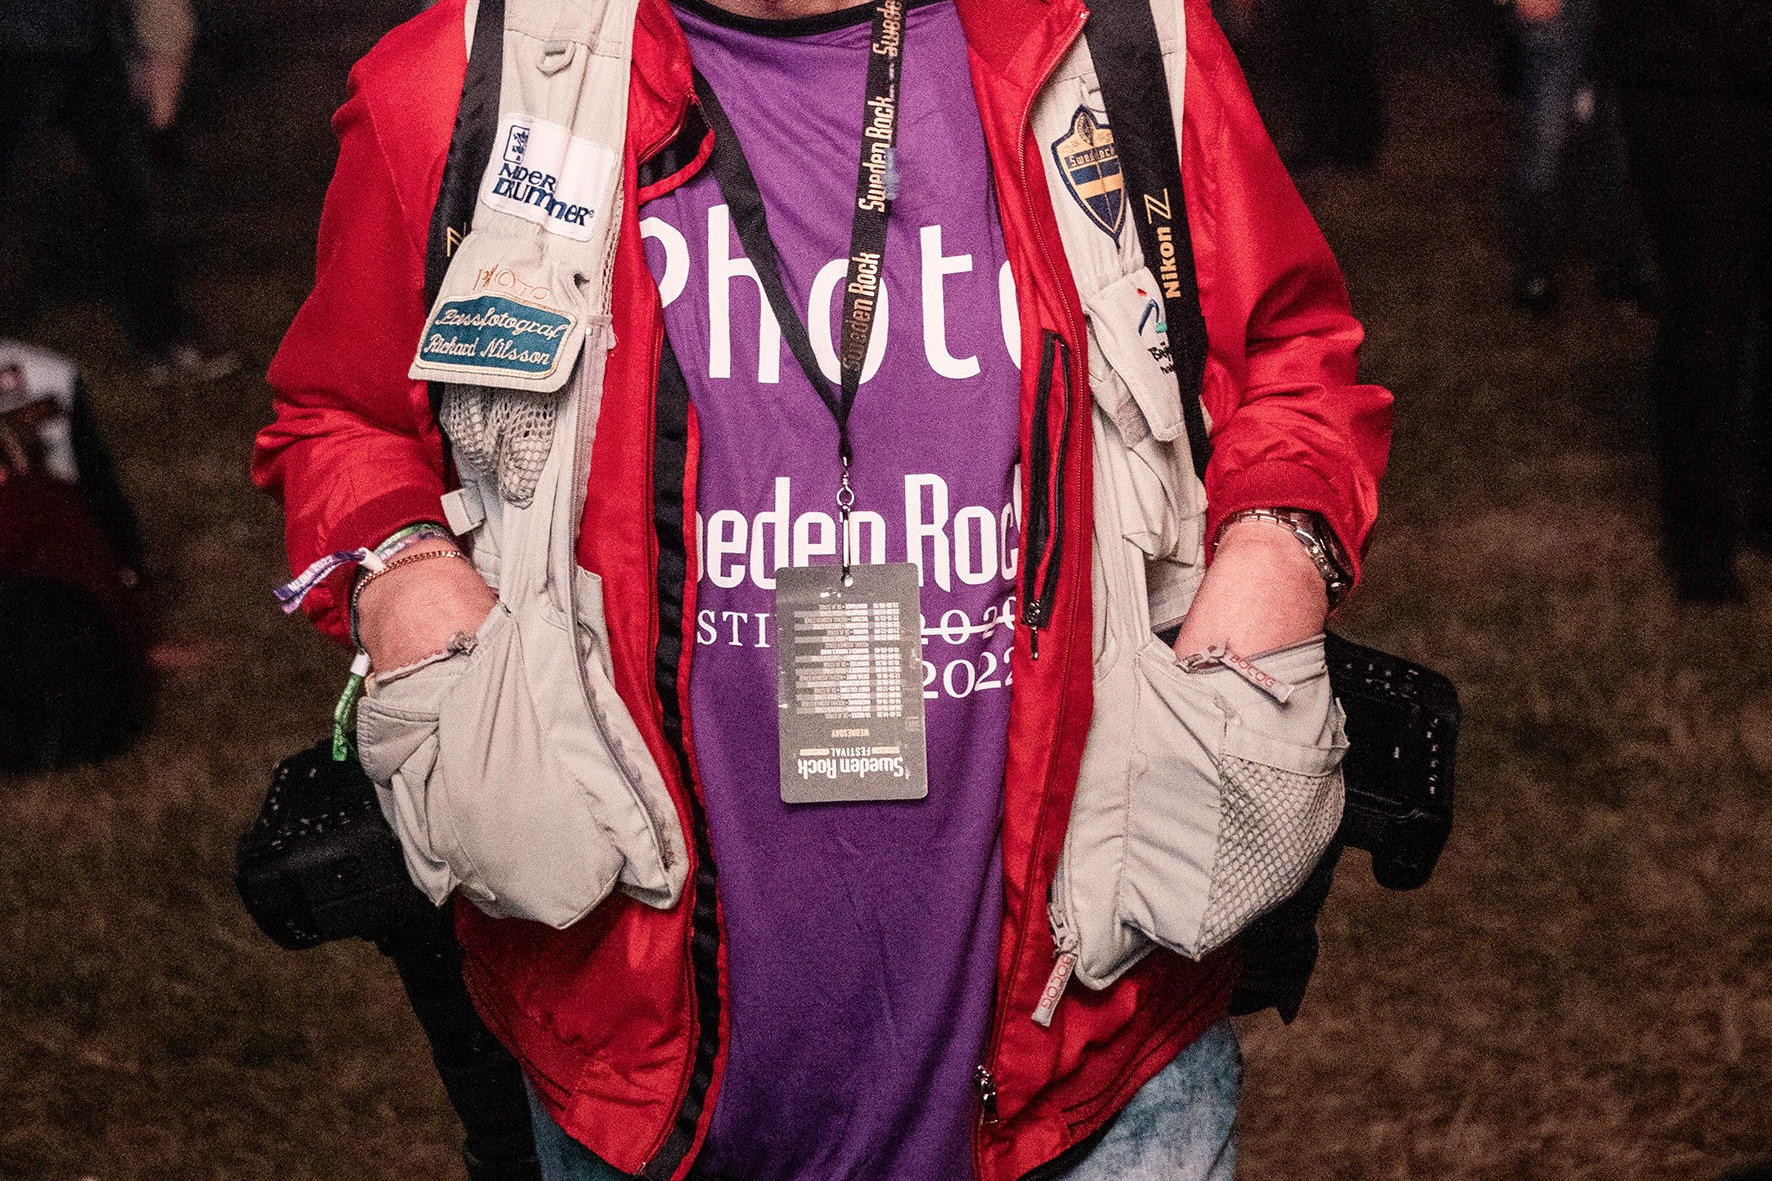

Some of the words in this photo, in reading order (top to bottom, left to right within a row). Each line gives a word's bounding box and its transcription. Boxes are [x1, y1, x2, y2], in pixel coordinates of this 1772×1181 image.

[865, 95, 895, 143] Rock
[859, 140, 890, 213] Sweden
[848, 252, 880, 298] Rock
[1157, 226, 1181, 299] Nikon
[639, 205, 1022, 385] Phot
[435, 307, 568, 339] Pressfotograf
[424, 333, 479, 357] Richard
[480, 337, 550, 366] Nilsson
[696, 476, 887, 590] eden
[905, 465, 1022, 592] Roc
[288, 566, 312, 592] MEDIA
[1230, 654, 1276, 688] BOCOG
[831, 728, 870, 738] WEDNESDAY
[797, 758, 838, 780] Rock
[831, 747, 871, 758] FESTIVAL
[840, 757, 904, 778] Sweden
[1041, 955, 1073, 1008] BOCOG
